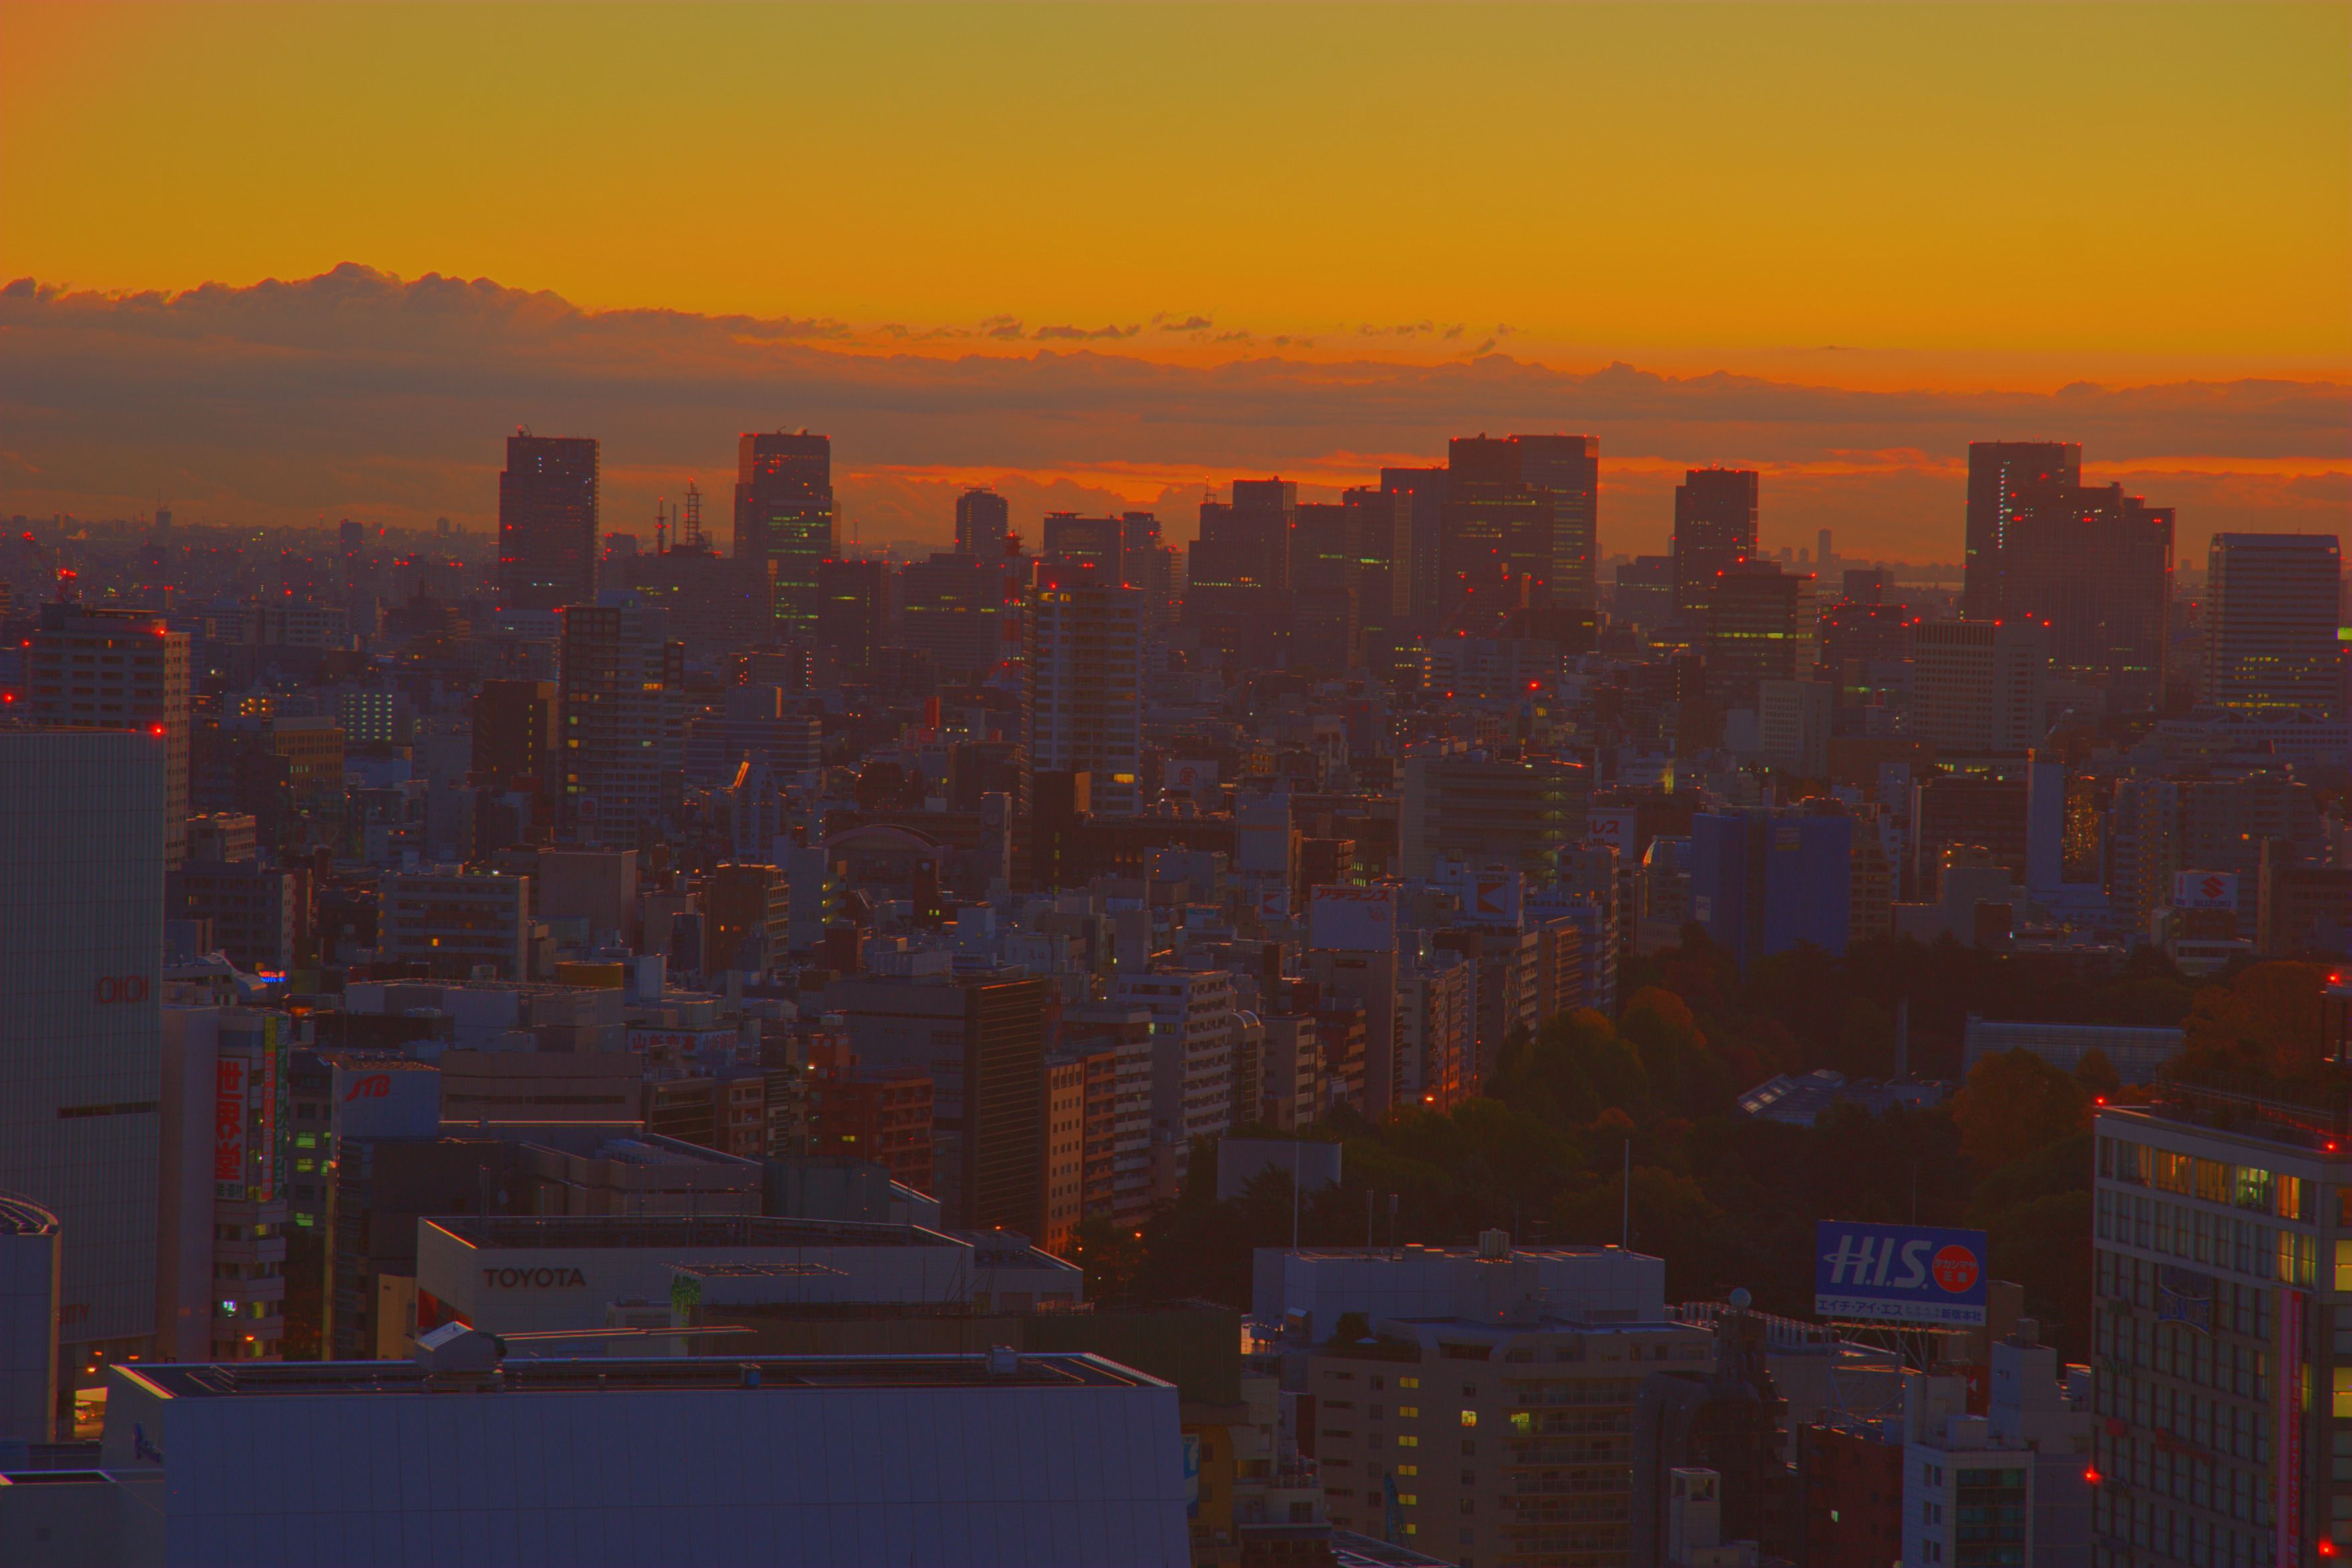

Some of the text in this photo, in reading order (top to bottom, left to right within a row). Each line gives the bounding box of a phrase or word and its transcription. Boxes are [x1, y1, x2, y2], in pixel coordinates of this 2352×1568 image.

[1315, 888, 1390, 902] アデランス
[2194, 899, 2231, 908] SUZUKI
[346, 1074, 391, 1102] JTB
[216, 1060, 243, 1179] 世界堂
[483, 1268, 586, 1288] TOYOTA
